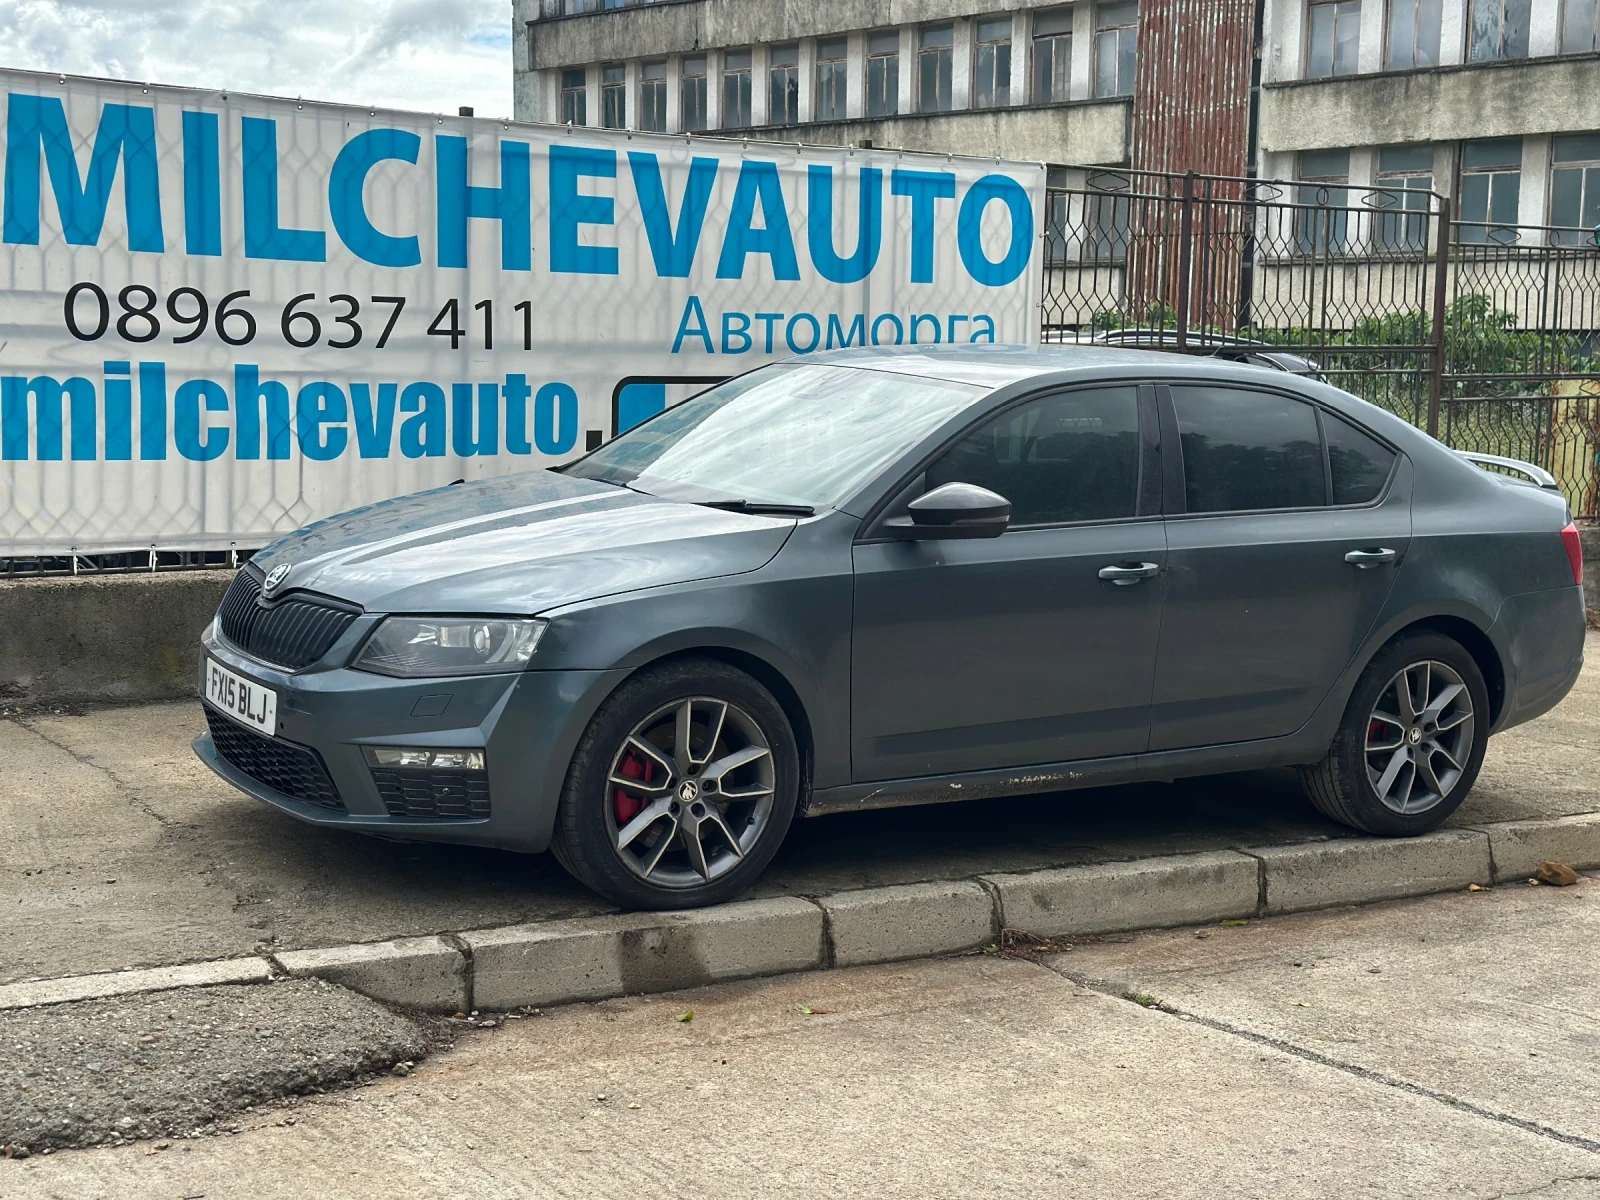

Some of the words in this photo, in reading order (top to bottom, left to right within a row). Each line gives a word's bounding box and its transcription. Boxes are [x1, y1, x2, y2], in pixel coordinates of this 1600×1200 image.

[3, 93, 1034, 286] MILCHEVAUTO
[64, 282, 257, 345] 0896
[280, 293, 406, 349] 637
[426, 299, 532, 350] 411
[212, 667, 236, 709] FX15
[238, 682, 267, 724] BLJ
